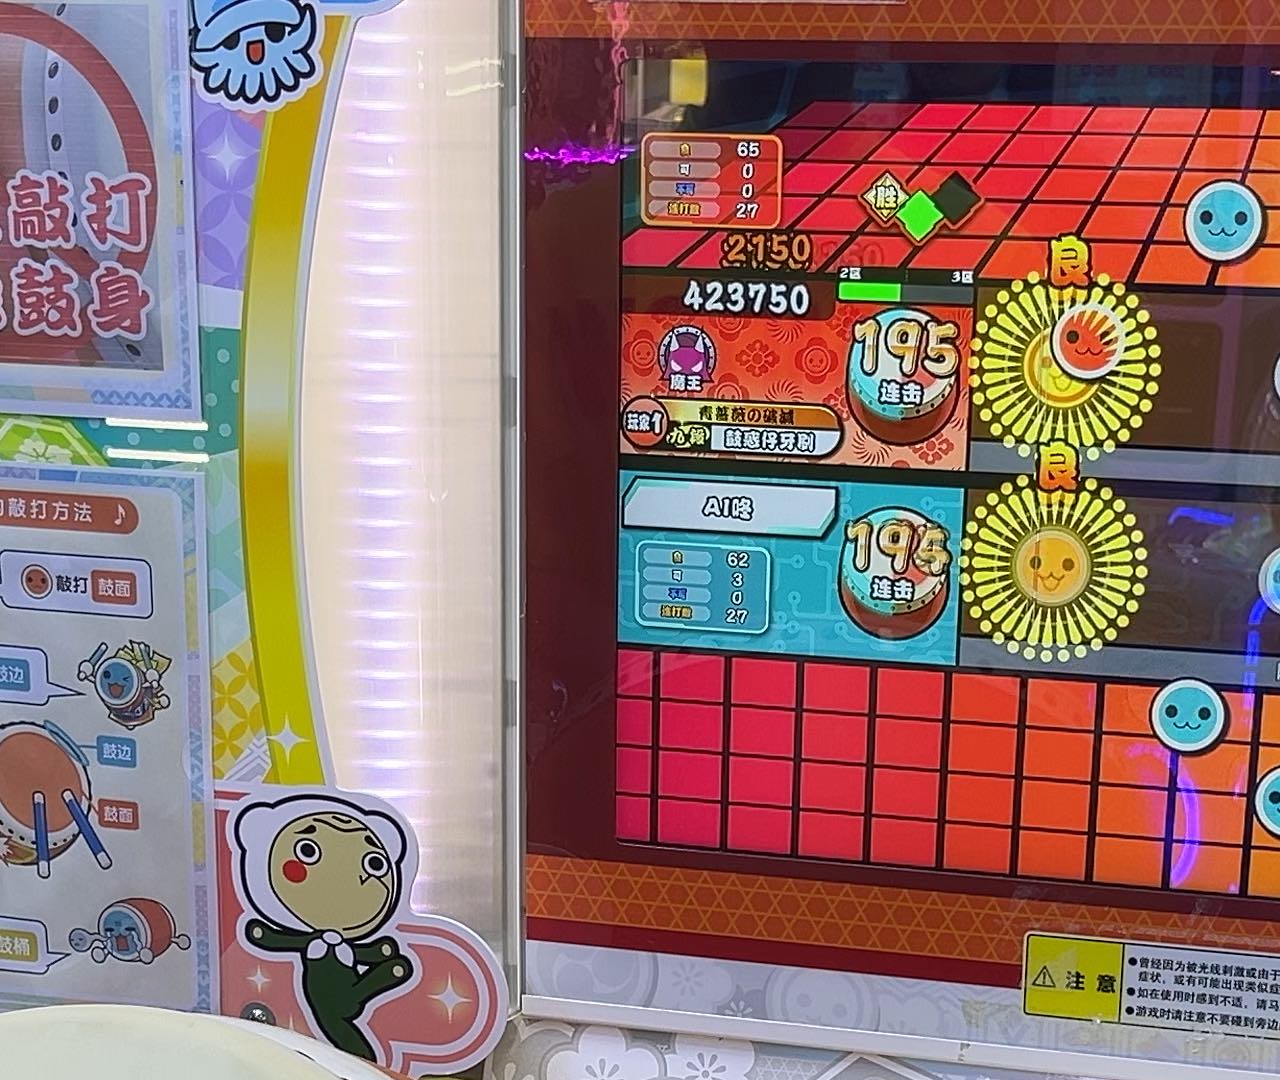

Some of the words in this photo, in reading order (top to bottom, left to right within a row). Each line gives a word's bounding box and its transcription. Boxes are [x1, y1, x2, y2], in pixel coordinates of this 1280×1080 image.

[736, 141, 761, 158] 65
[741, 163, 754, 179] 0
[741, 183, 754, 199] 0
[875, 184, 897, 210] 胜
[736, 202, 759, 219] 27
[1051, 236, 1090, 286] 良
[683, 280, 811, 316] 423750
[854, 319, 960, 377] 195
[878, 380, 924, 406] 连击
[1039, 441, 1079, 491] 良
[703, 496, 754, 520] AI咚
[726, 551, 750, 569] 62
[55, 573, 88, 595] 敲打
[96, 577, 132, 598] 鼓面
[731, 572, 744, 588] 3
[870, 575, 914, 600] 连击
[731, 590, 743, 605] 0
[725, 608, 749, 625] 27
[100, 741, 134, 762] 鼓边
[102, 804, 134, 823] 鼓面
[1064, 969, 1117, 994] 注意
